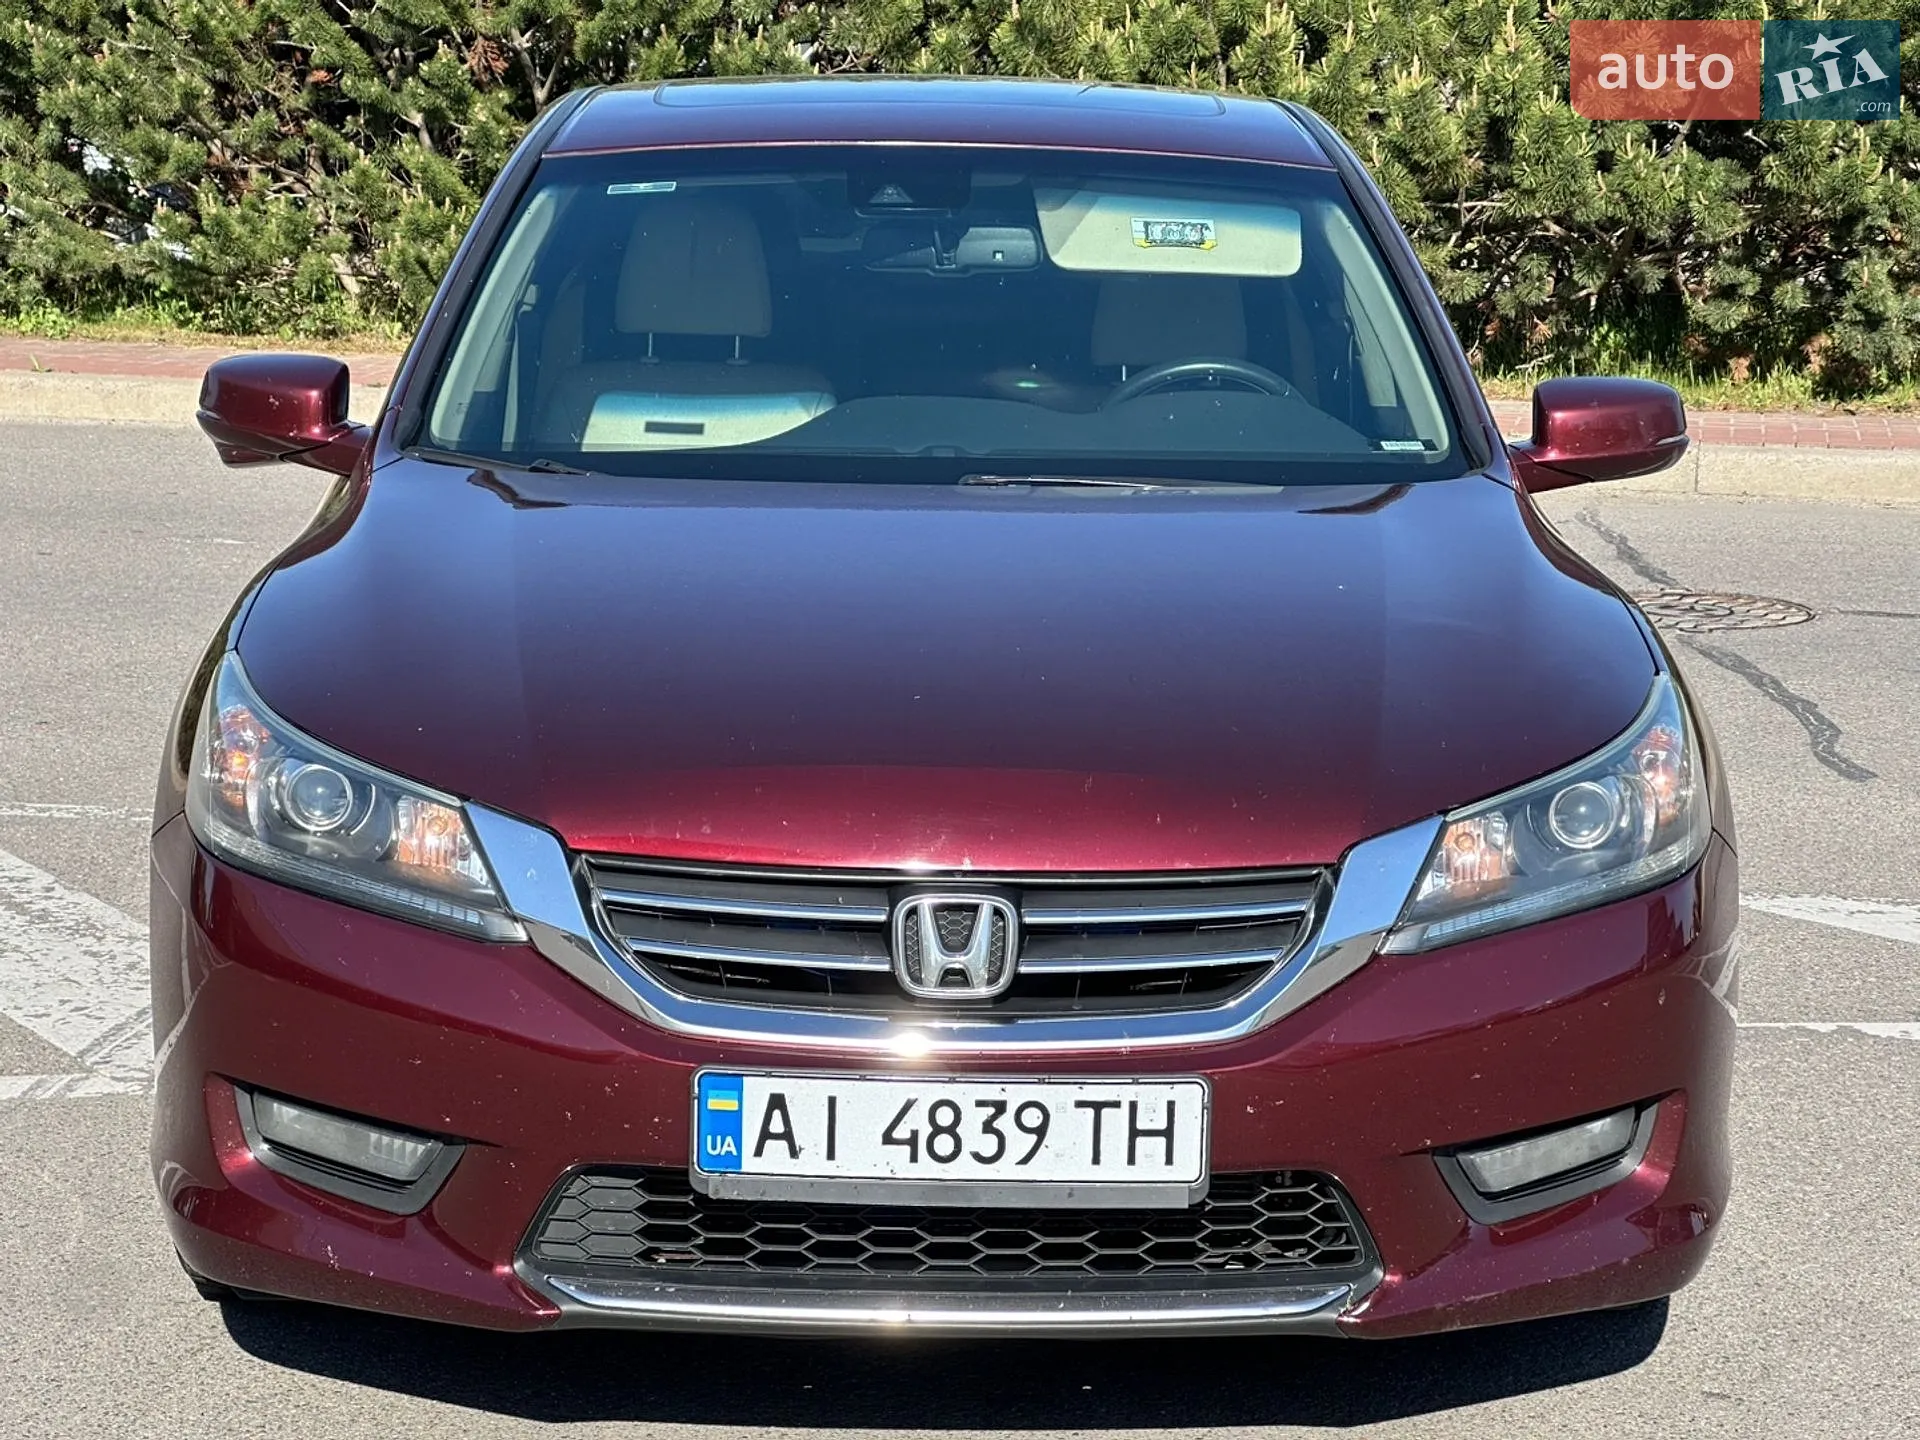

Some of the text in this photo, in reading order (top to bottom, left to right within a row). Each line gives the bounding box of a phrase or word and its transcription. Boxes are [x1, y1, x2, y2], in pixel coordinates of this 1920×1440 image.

[706, 1092, 1175, 1166] UA AI 4839 TH
